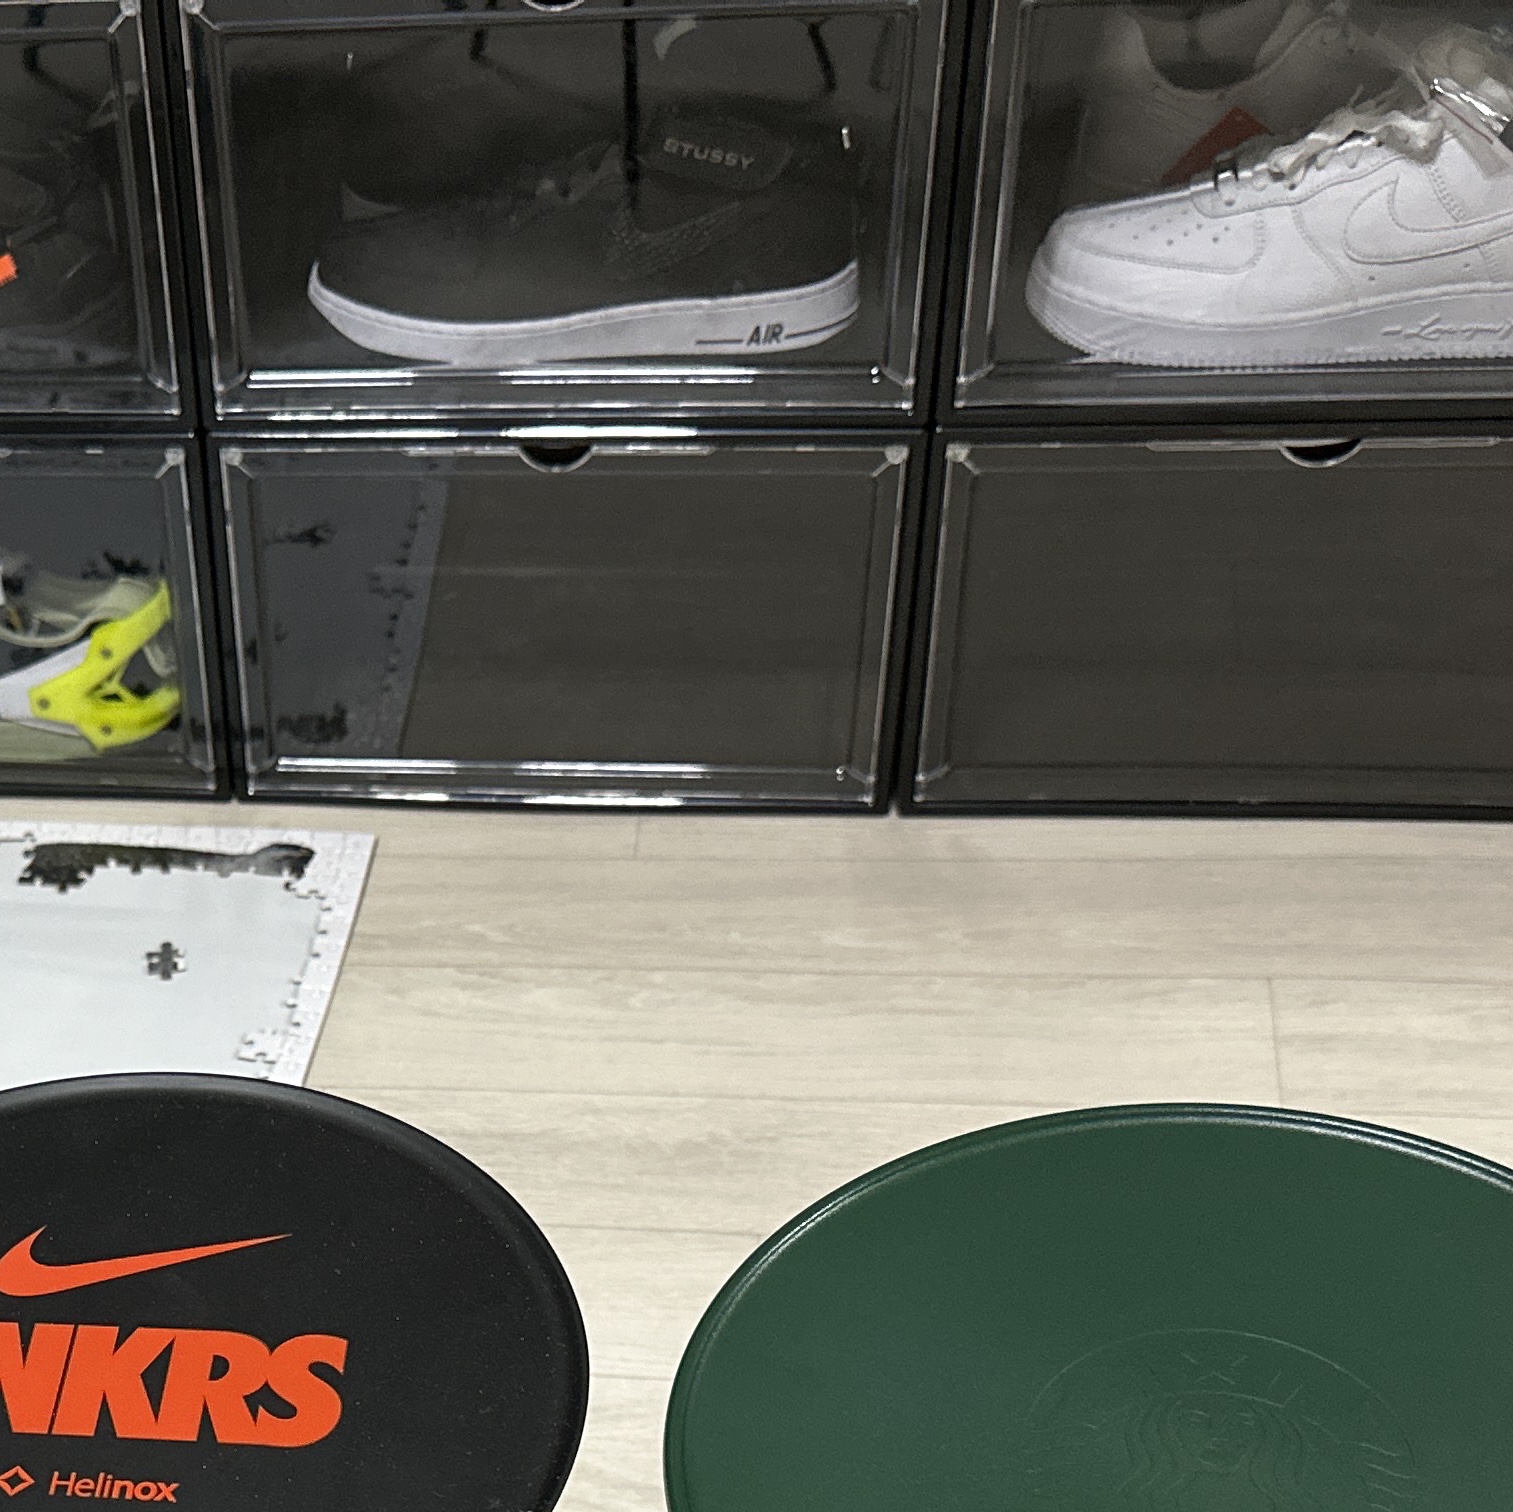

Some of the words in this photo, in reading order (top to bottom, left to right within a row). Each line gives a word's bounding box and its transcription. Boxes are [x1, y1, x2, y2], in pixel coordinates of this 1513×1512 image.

[663, 138, 756, 171] STUSSY
[746, 323, 784, 346] AIR
[49, 1471, 180, 1504] Helinox
